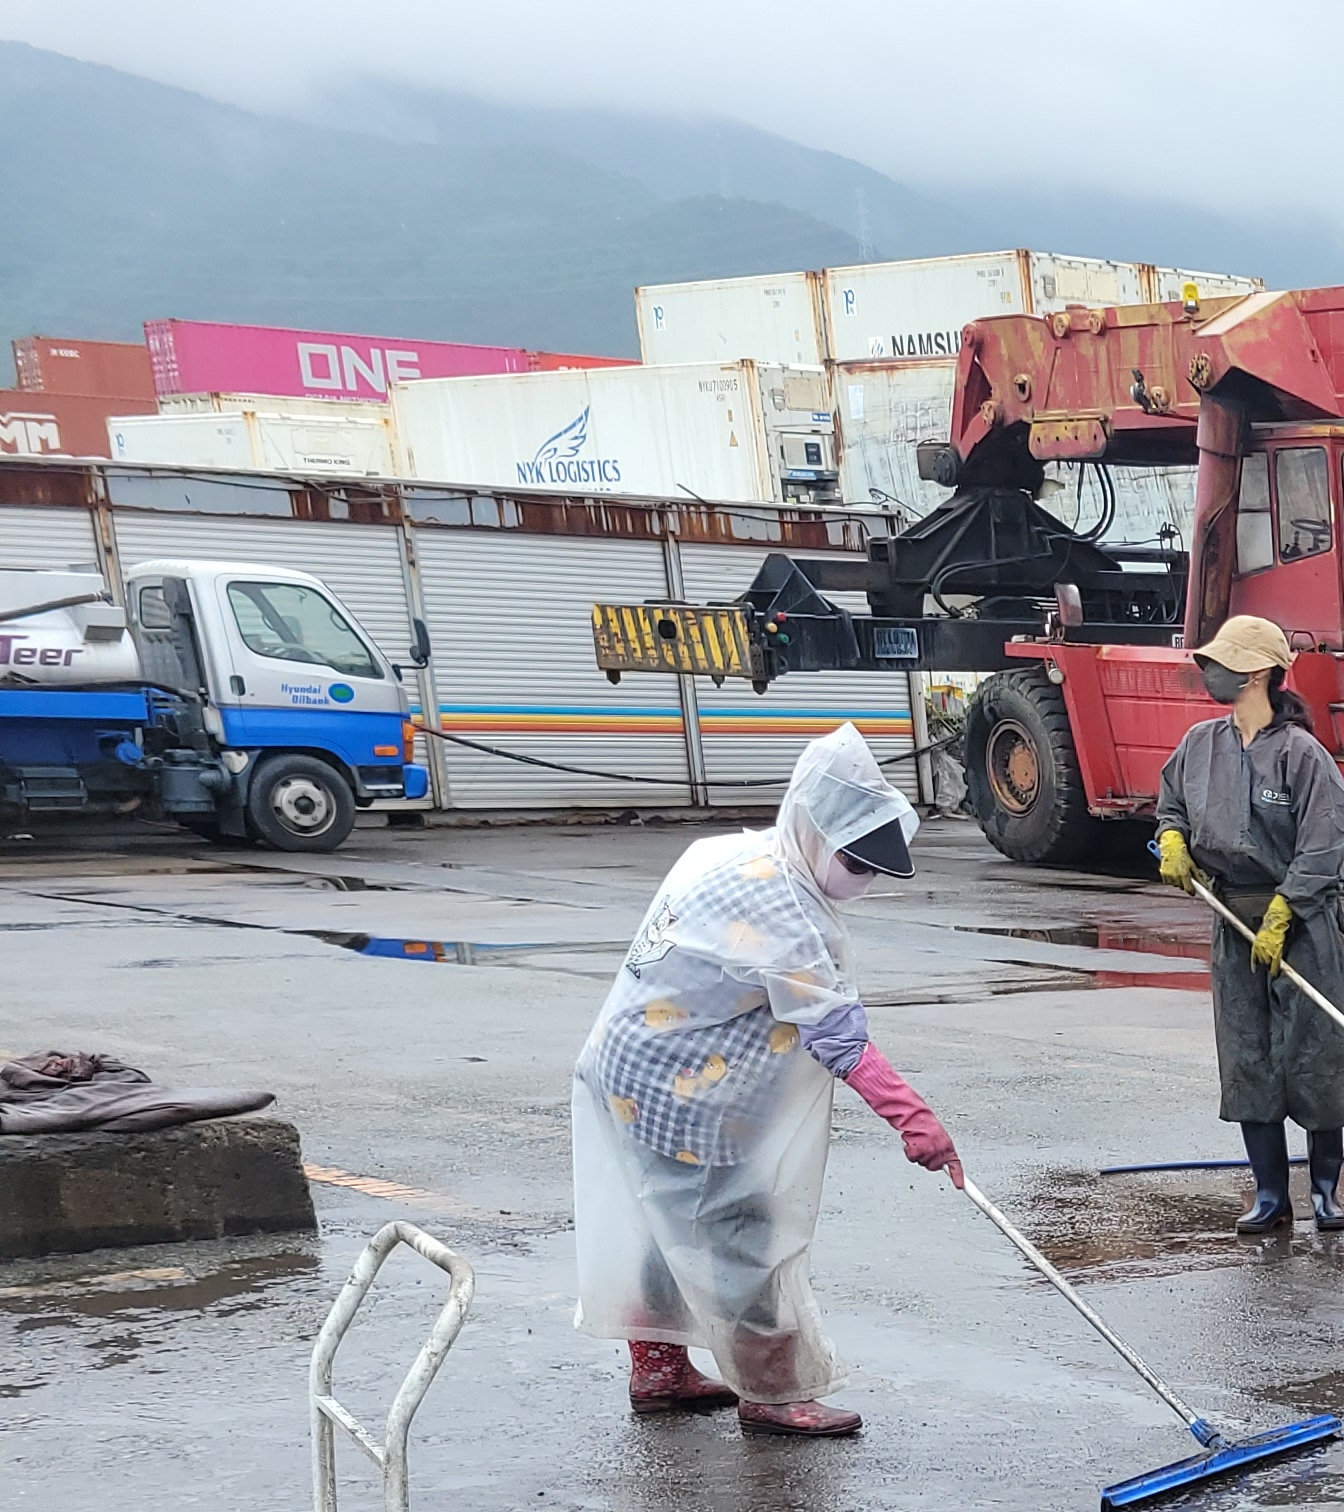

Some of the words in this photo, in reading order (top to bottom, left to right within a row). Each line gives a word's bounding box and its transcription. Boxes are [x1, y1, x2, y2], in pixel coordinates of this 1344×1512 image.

[892, 330, 963, 356] NAMSU
[297, 342, 421, 393] ONE
[516, 461, 546, 484] NYK
[548, 460, 621, 483] LOGISTICS
[281, 683, 322, 694] Hyundai
[292, 695, 330, 705] Oilbank
